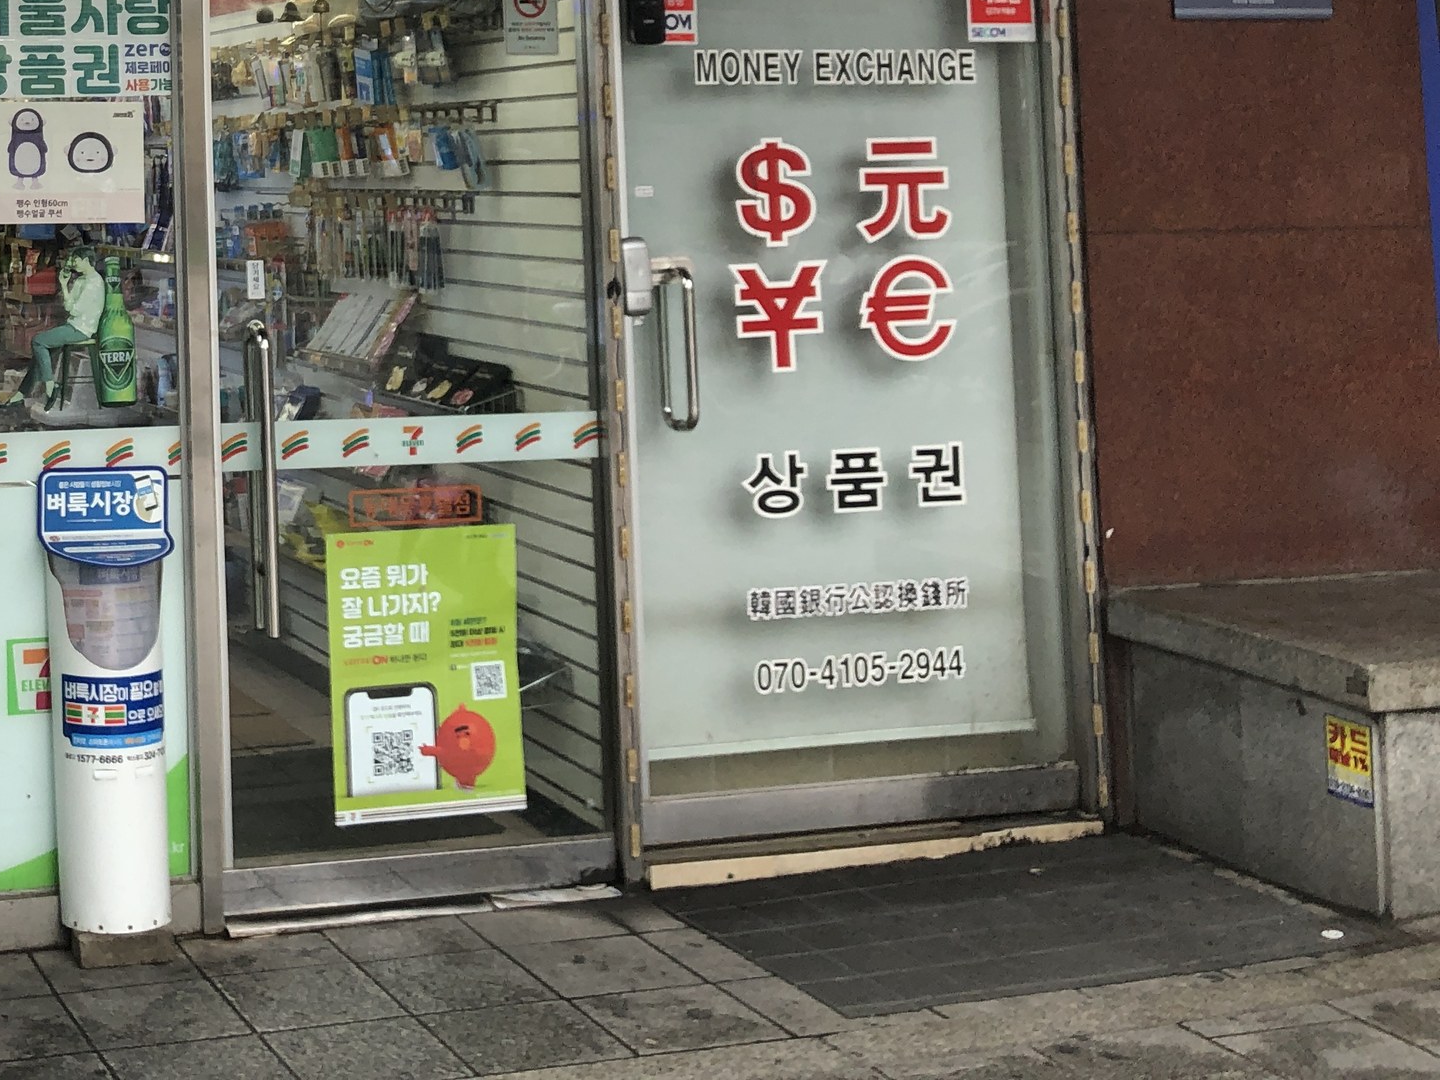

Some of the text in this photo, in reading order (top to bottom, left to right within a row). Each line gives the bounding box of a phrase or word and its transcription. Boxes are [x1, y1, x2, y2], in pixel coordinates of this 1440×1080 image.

[695, 49, 976, 84] MONEY EXCHANGE
[860, 139, 951, 242] 元
[101, 351, 132, 364] TERRA
[46, 490, 134, 517] 벼룩시장
[340, 563, 429, 590] 요즘 뭐가
[341, 591, 442, 619] 잘 나가지?
[343, 621, 429, 648] 궁금할 때
[756, 647, 964, 692] 070-4105-2944
[21, 679, 51, 692] ELEV
[76, 754, 124, 764] 1577-6666
